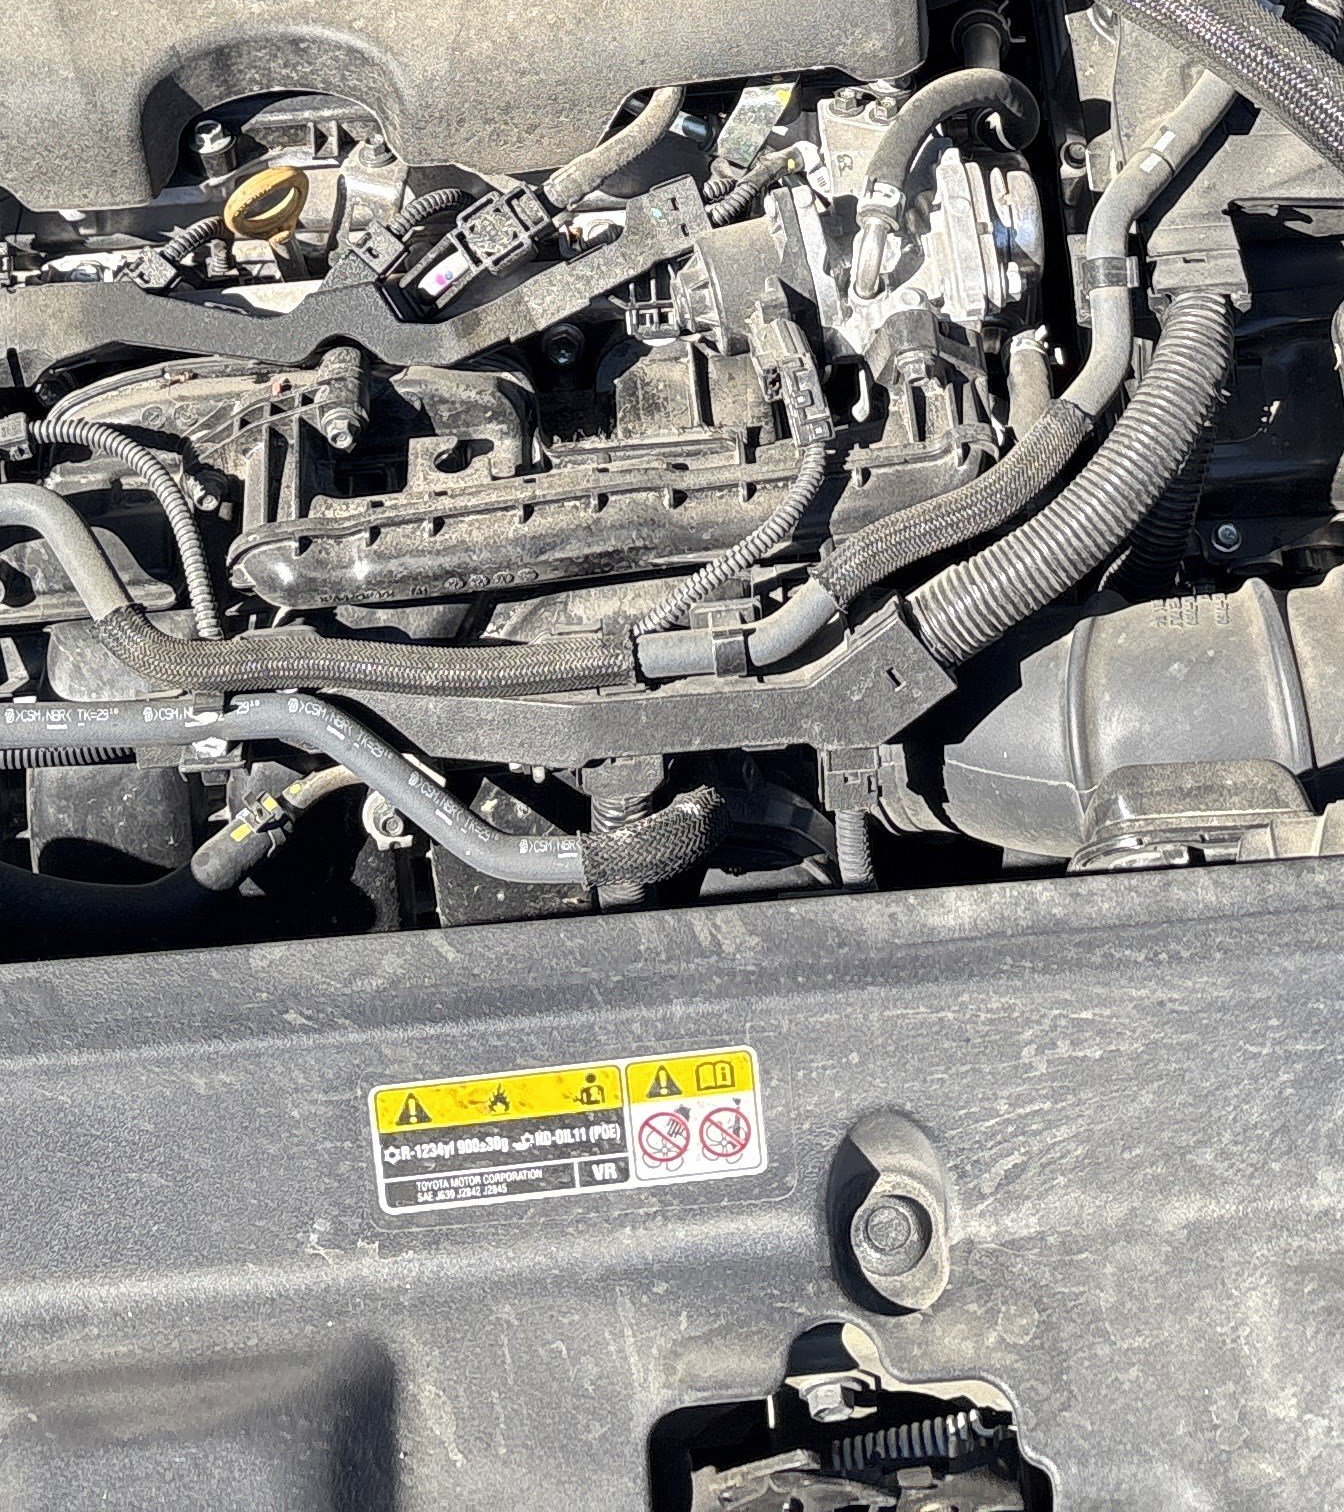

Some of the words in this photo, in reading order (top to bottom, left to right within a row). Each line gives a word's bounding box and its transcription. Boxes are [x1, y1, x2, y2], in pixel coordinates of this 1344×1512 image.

[589, 1122, 621, 1143] (POE)
[416, 1179, 450, 1192] TOYOTA
[450, 1176, 481, 1188] MOTOR
[482, 1169, 543, 1185] CORPORATION
[591, 1162, 618, 1181] VR
[417, 1191, 435, 1203] SAE
